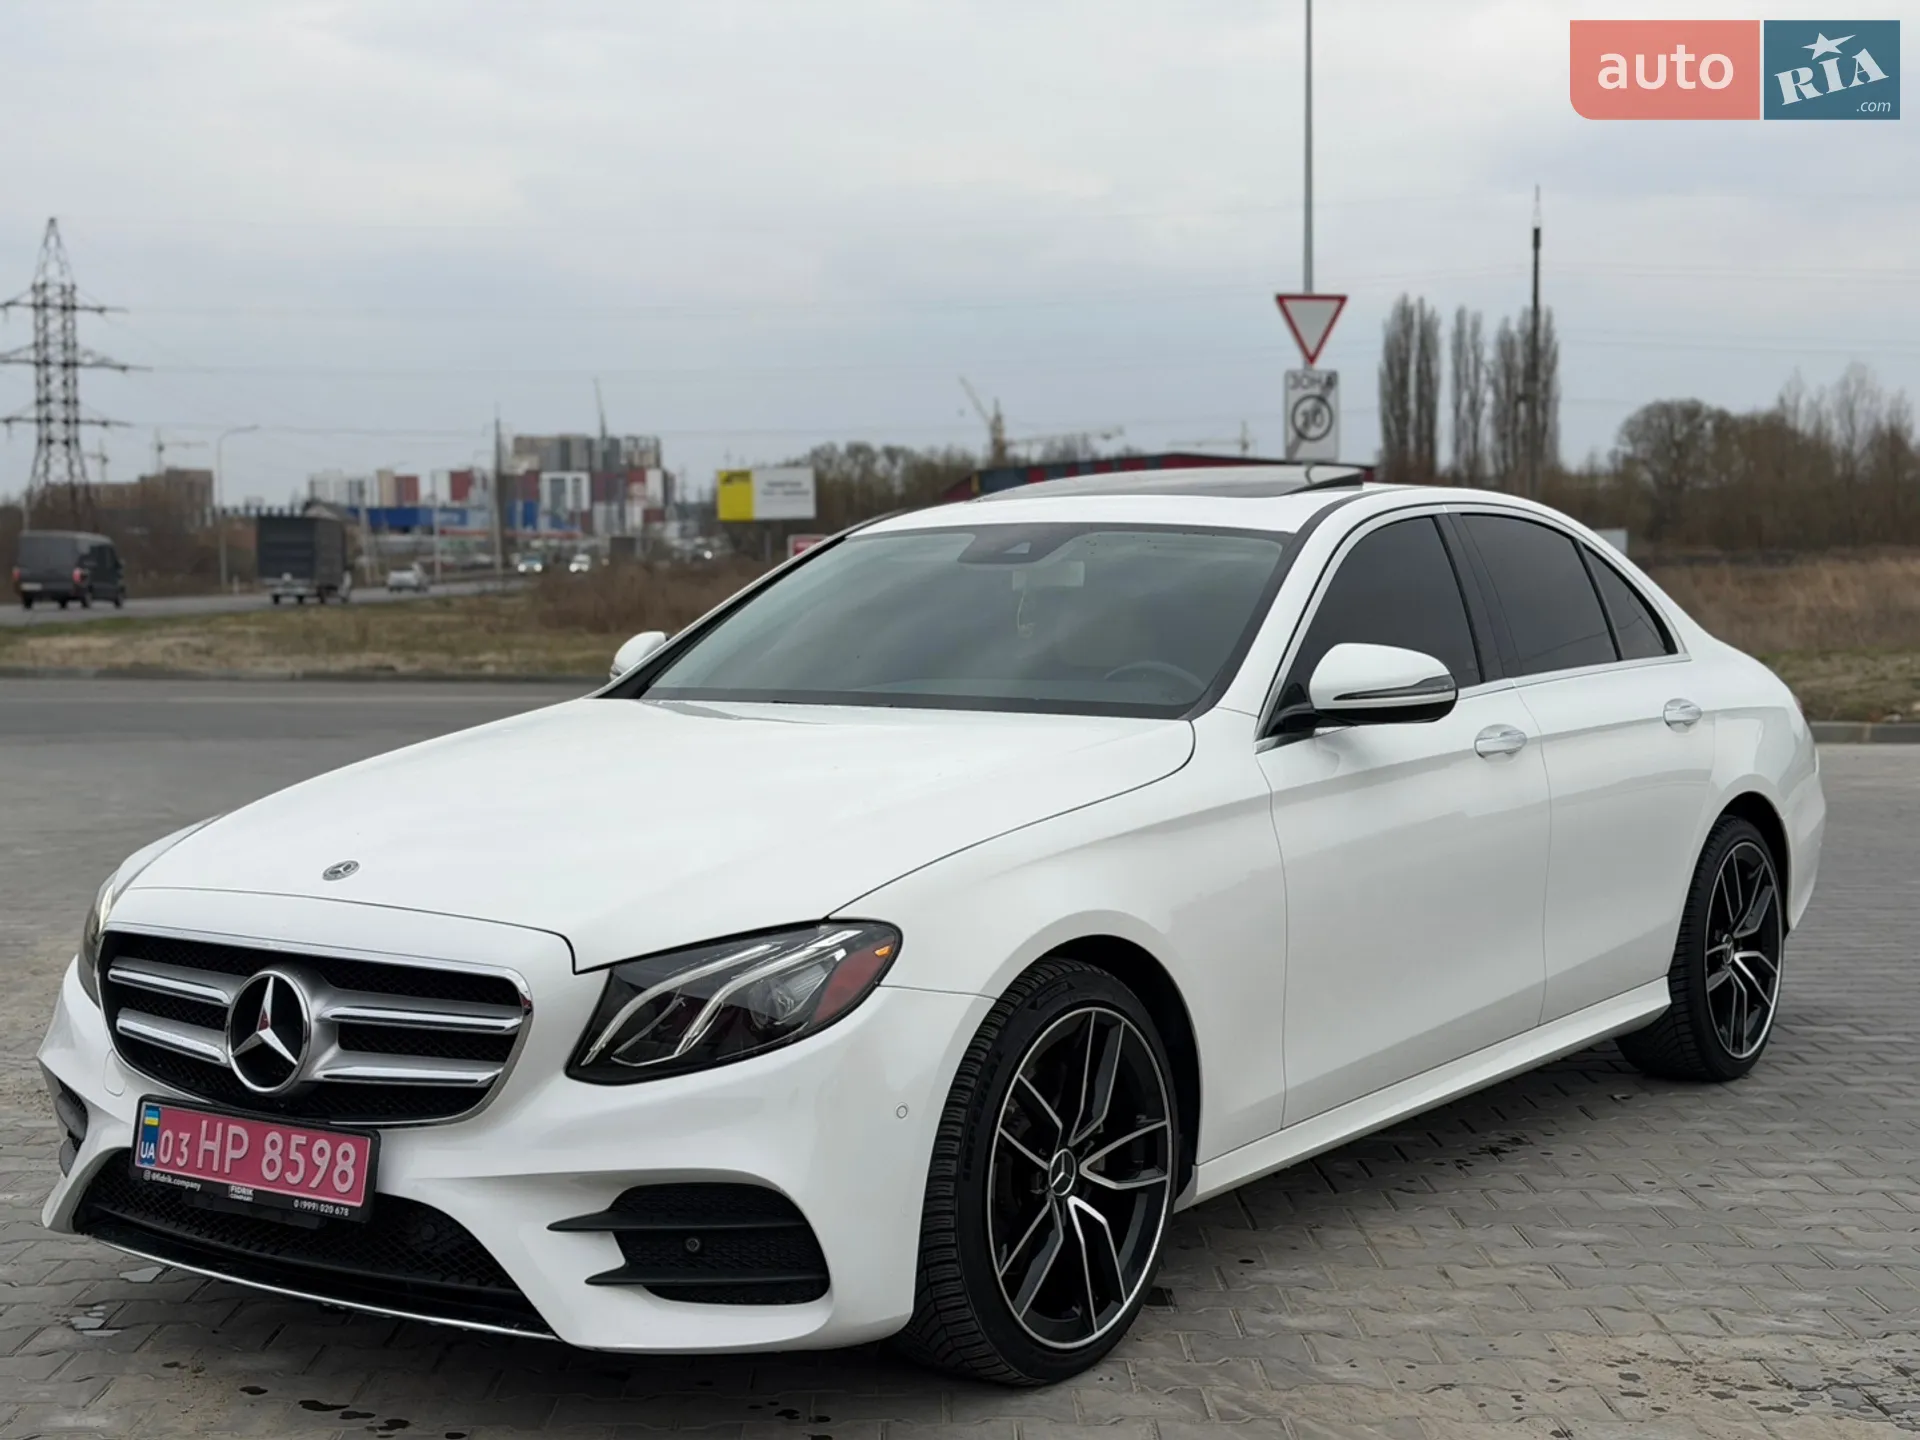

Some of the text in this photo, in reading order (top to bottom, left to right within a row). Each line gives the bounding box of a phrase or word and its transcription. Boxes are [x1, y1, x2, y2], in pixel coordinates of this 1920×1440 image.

[140, 1141, 155, 1159] UA
[159, 1119, 356, 1194] 03 HP 8598
[293, 1199, 300, 1208] 0
[319, 1203, 334, 1214] 020
[334, 1206, 350, 1216] 678
